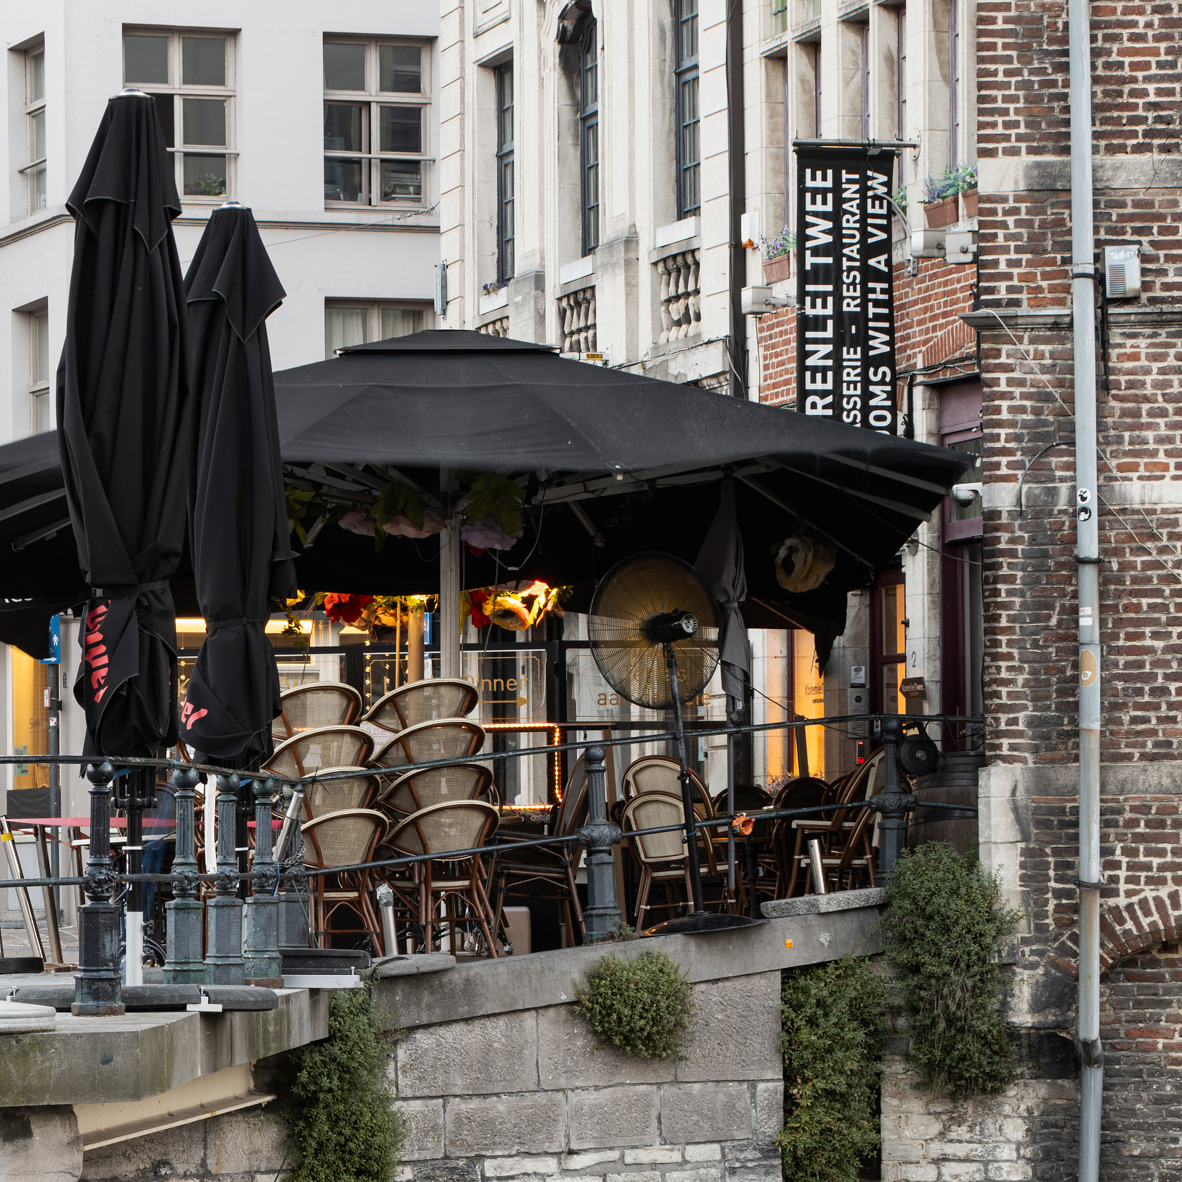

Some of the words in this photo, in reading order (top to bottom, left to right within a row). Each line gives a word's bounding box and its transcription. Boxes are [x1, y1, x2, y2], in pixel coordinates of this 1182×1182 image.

[805, 168, 833, 271] TWEE
[841, 169, 861, 312] RESTAURANT
[866, 170, 888, 244] VIEW
[867, 253, 889, 272] A
[868, 282, 891, 356] WITH
[842, 346, 861, 428] SSERIE
[868, 366, 892, 435] OMS
[911, 651, 917, 668] 2
